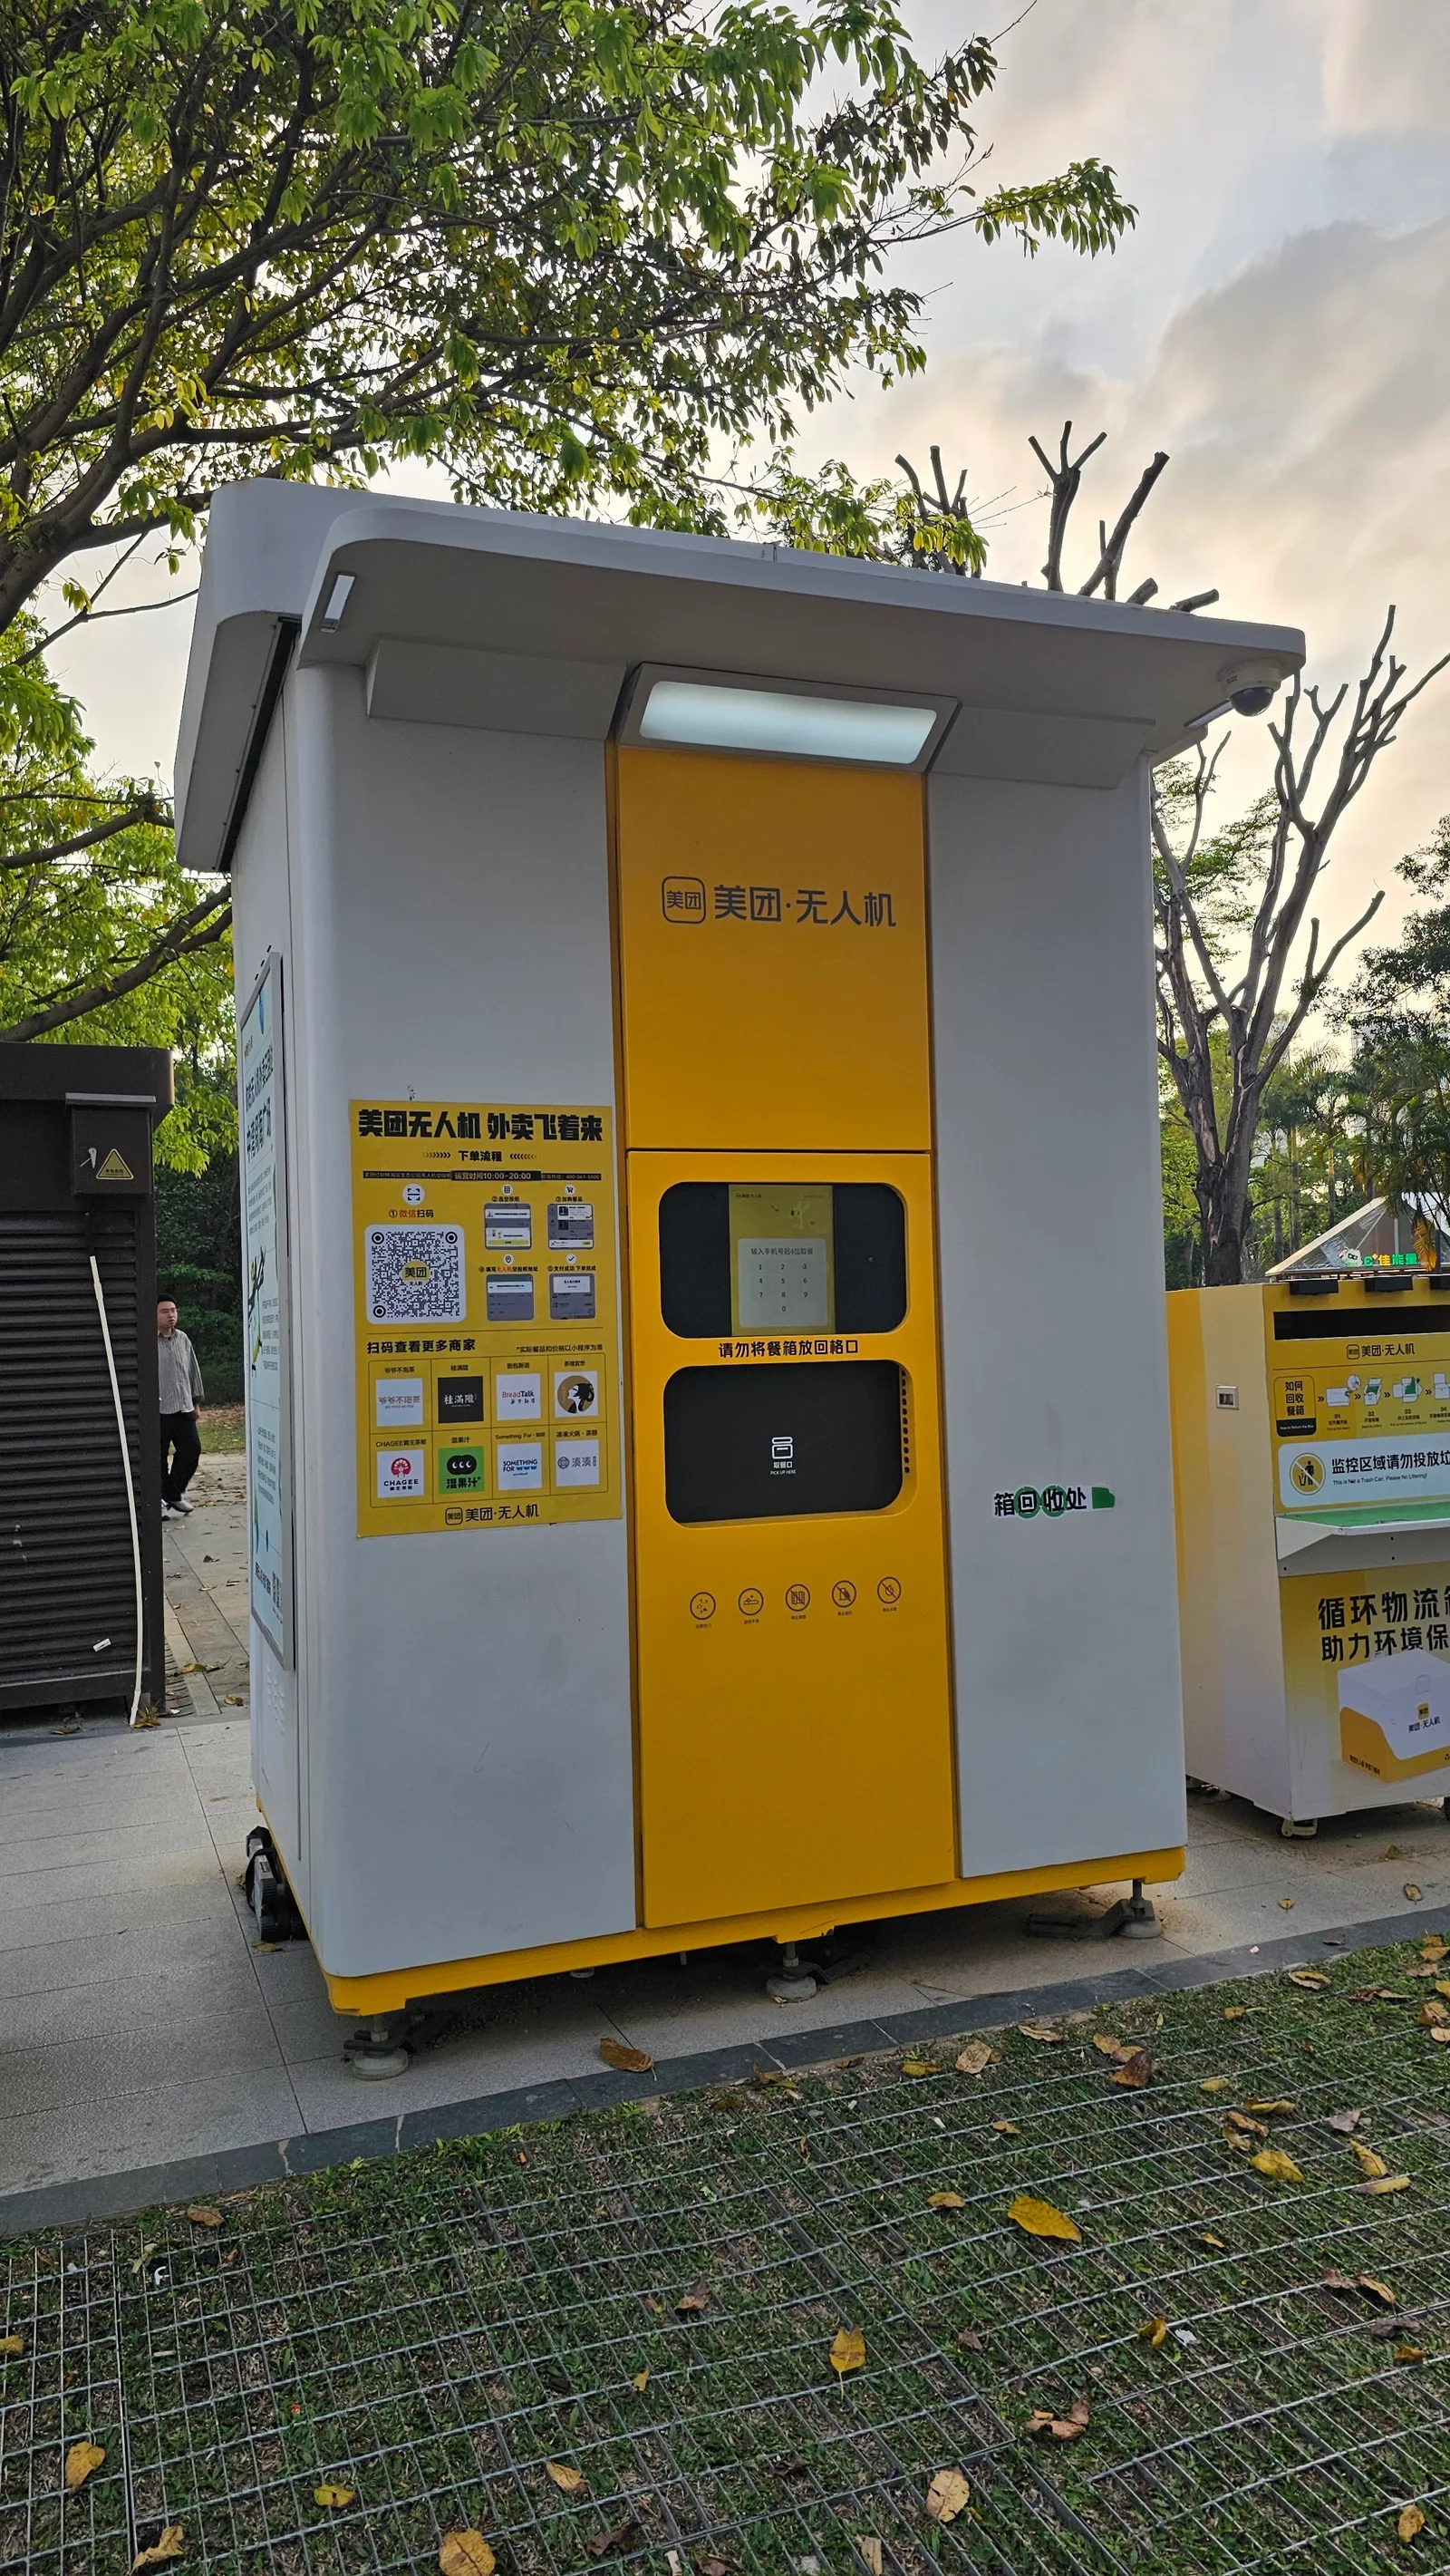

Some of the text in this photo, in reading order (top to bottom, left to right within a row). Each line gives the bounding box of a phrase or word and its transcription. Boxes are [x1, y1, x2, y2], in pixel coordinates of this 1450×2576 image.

[666, 885, 896, 926] 美团 美团·无人机
[359, 1109, 604, 1142] 美团无人机 外卖飞着来
[458, 1150, 503, 1162] 下单流程
[404, 1267, 427, 1278] 美团
[366, 1339, 476, 1354] 扫码查看更多商家
[719, 1339, 858, 1359] 请勿将餐箱放回格口
[1361, 1342, 1416, 1358] 美团·无人机
[1285, 1380, 1303, 1391] 如何
[502, 1390, 535, 1399] BreadTalk
[1286, 1393, 1304, 1403] 回收
[503, 1458, 538, 1467] SOMETHING
[383, 1478, 419, 1487] CHAGEE
[993, 1487, 1088, 1516] 箱回收处
[465, 1504, 539, 1522] 美团·无人机
[1318, 1584, 1450, 1631] 循环物流
[1321, 1623, 1450, 1662] 助力环境保
